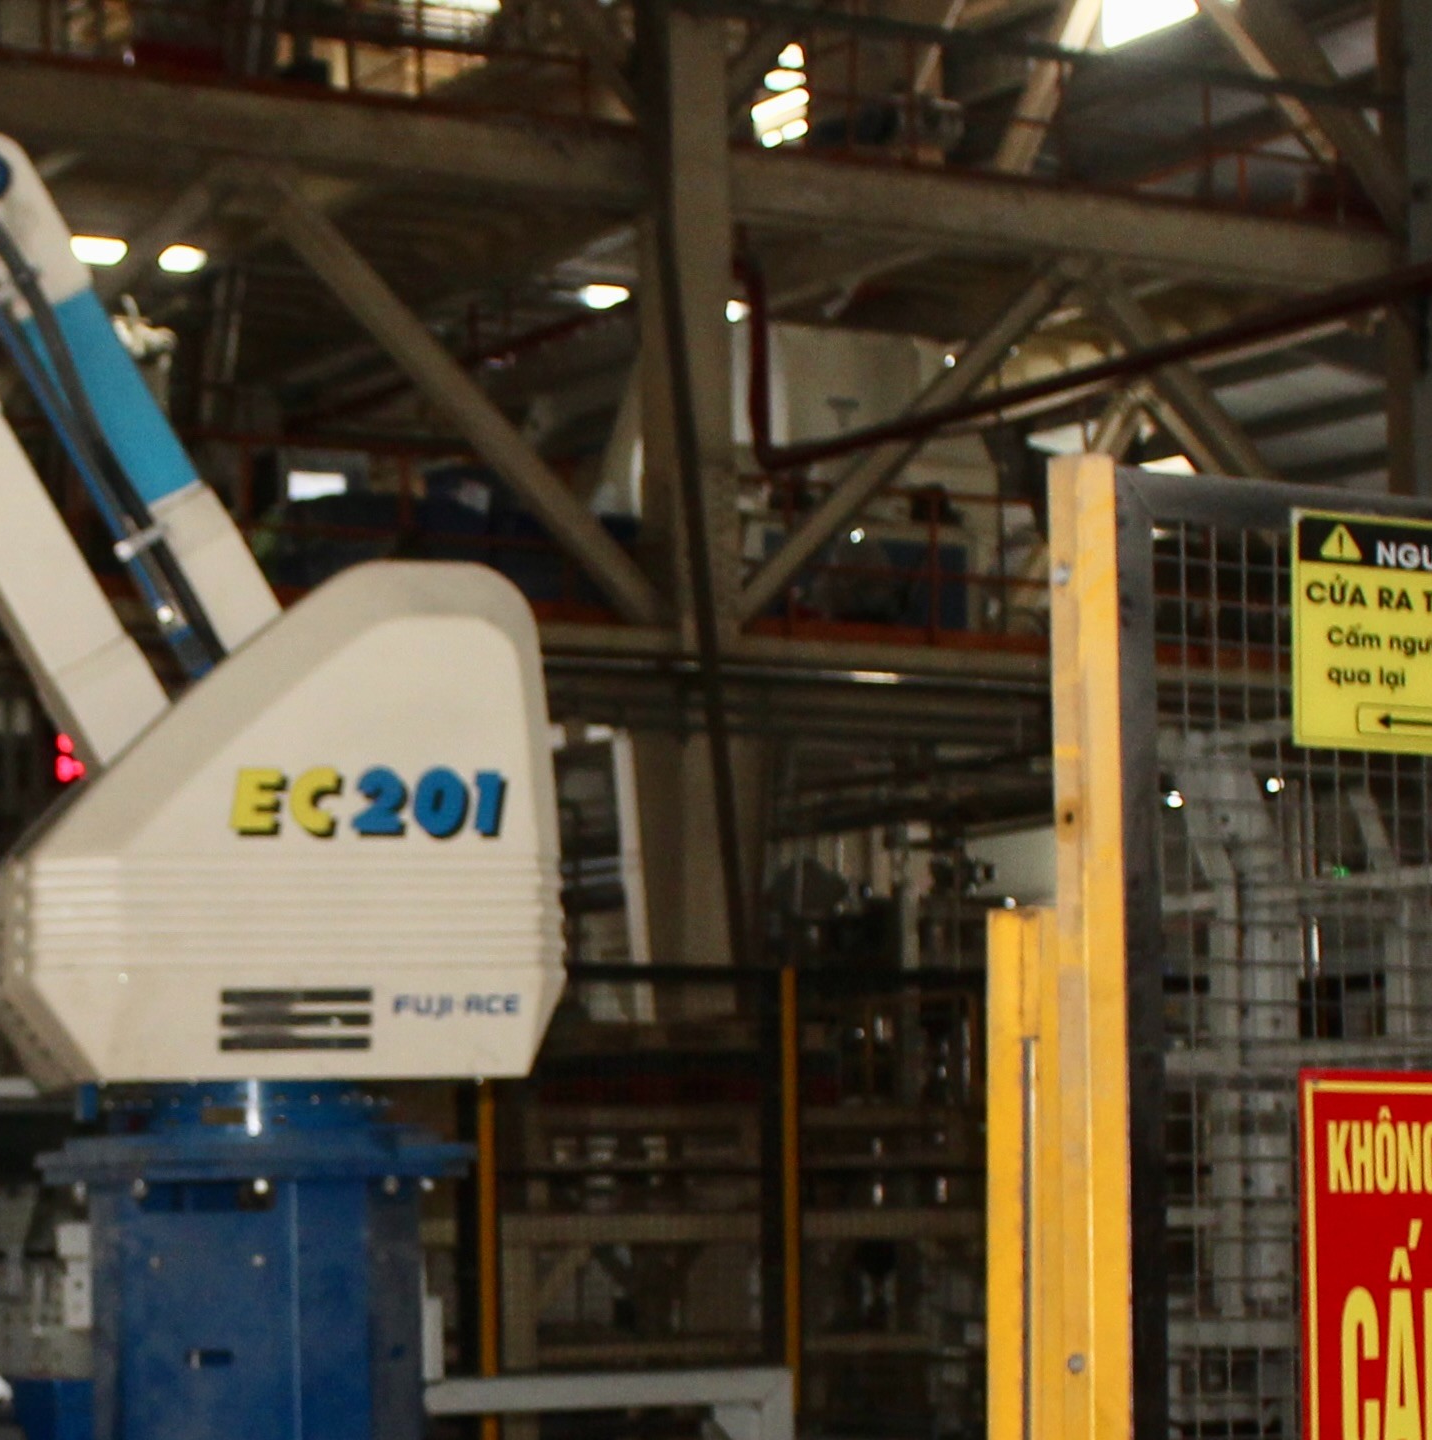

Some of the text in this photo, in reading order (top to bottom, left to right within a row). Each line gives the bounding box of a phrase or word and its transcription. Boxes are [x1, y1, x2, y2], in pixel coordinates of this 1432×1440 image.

[1306, 574, 1367, 608] CỬA
[1378, 587, 1413, 612] RA
[1327, 623, 1381, 648] Cấm
[1327, 667, 1406, 691] qua lại
[229, 765, 508, 838] EC201
[393, 994, 519, 1018] FUJI ACE
